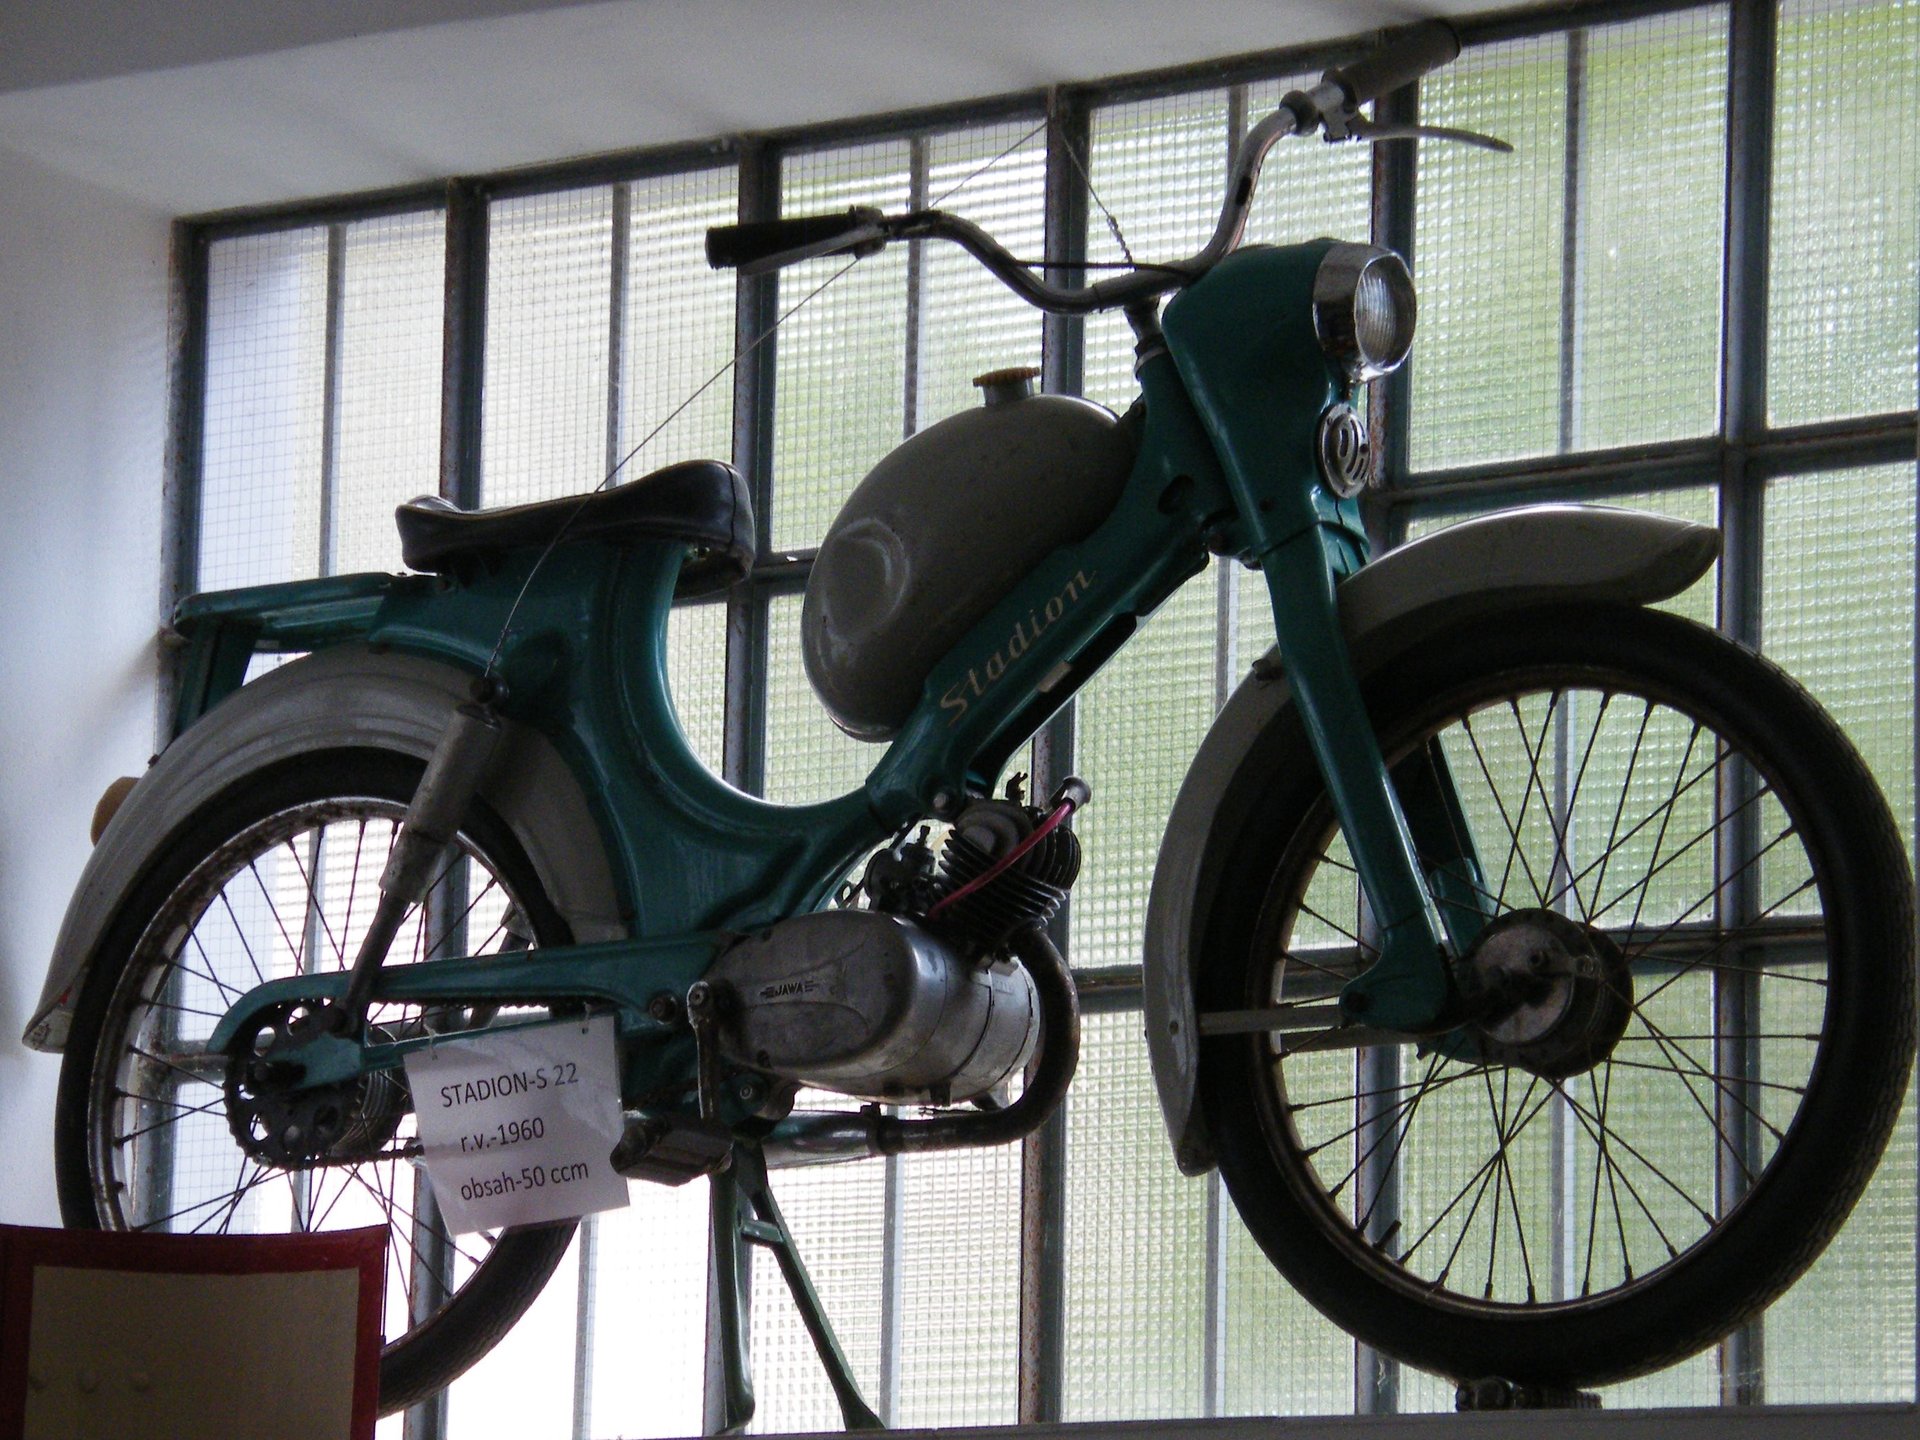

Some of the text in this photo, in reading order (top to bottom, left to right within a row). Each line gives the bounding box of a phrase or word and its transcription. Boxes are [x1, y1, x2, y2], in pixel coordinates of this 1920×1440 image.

[940, 569, 1097, 727] Stadion
[775, 982, 803, 996] JAWA
[441, 1062, 579, 1108] STADION-S 22
[461, 1117, 545, 1152] r.v.-1960
[461, 1162, 589, 1201] obsah-50 ccm
